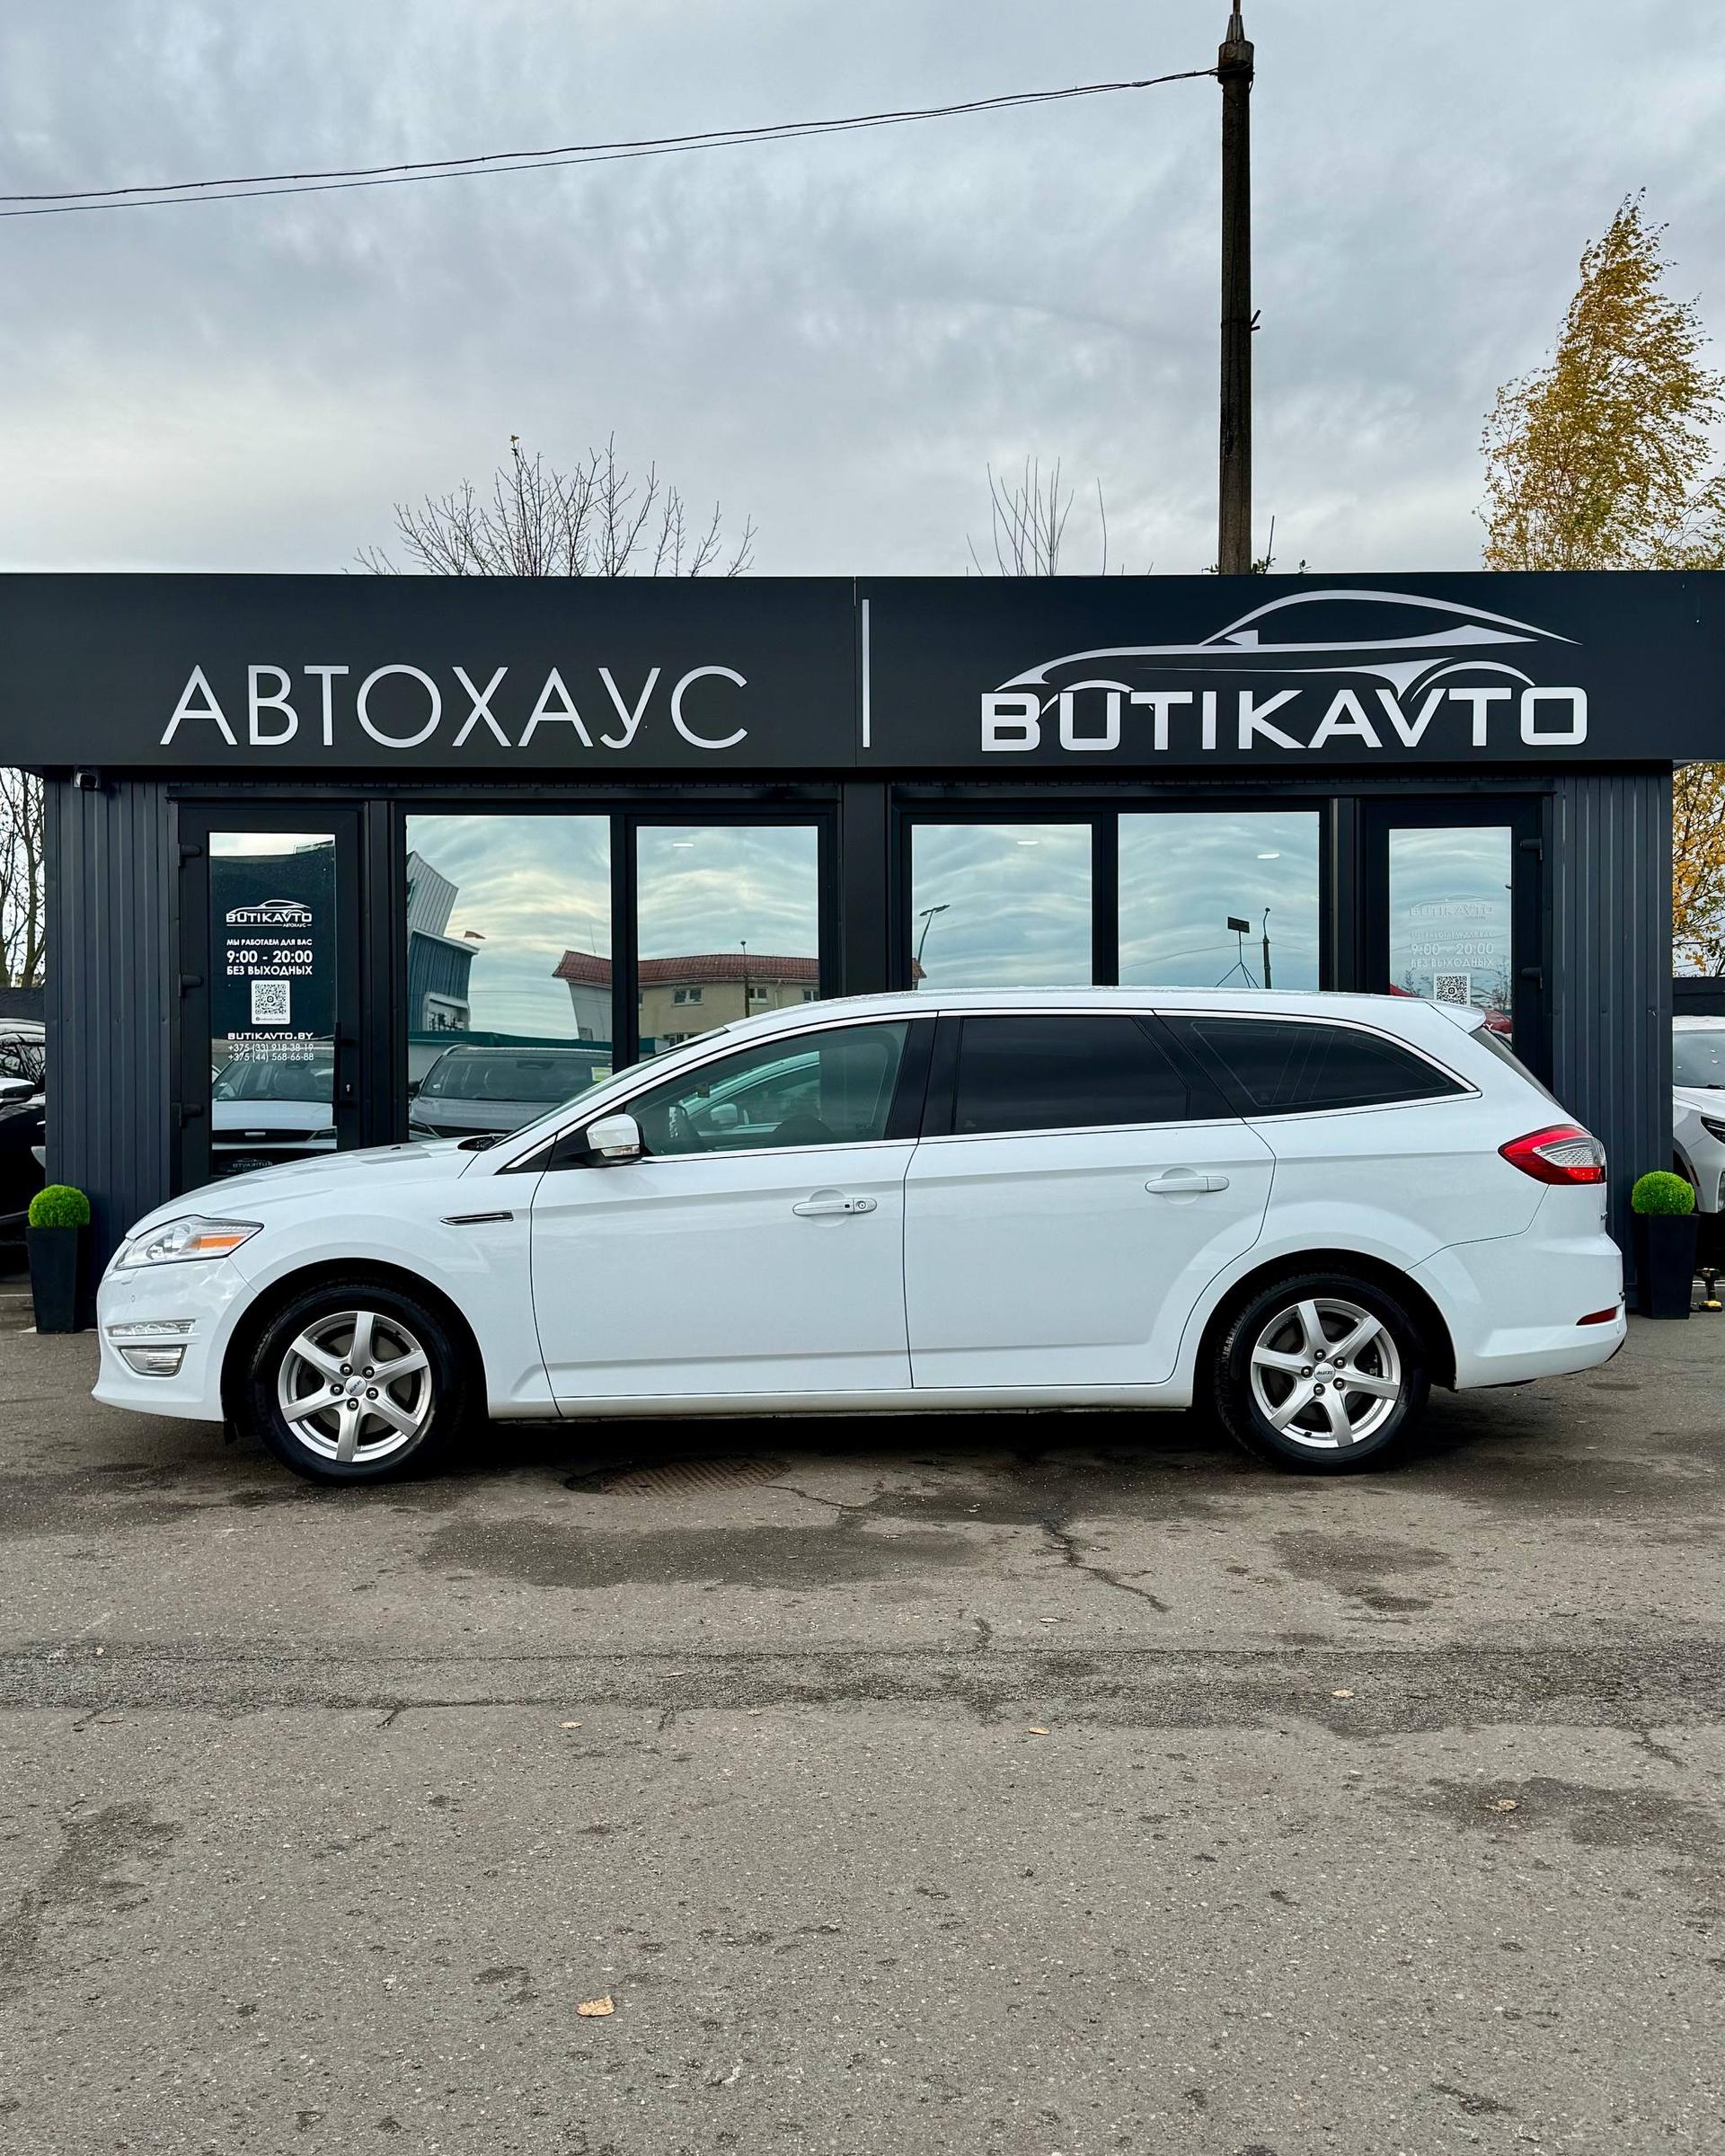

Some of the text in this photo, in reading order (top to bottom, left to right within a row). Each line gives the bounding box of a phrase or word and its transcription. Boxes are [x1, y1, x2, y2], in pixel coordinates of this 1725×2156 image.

[159, 664, 748, 750] АВТОХАУС
[981, 685, 1588, 752] BUTIKAVTO
[226, 913, 313, 923] BUTIKAVTO
[226, 950, 258, 963] 9:00
[272, 950, 313, 963] 20:00
[226, 966, 313, 976] БЕЗ ВЫХОДНЫХ
[227, 1032, 314, 1040] BUTIKAVTO.BY
[228, 1043, 250, 1052] +375
[228, 1052, 314, 1063] +375 (44) 568-66-88
